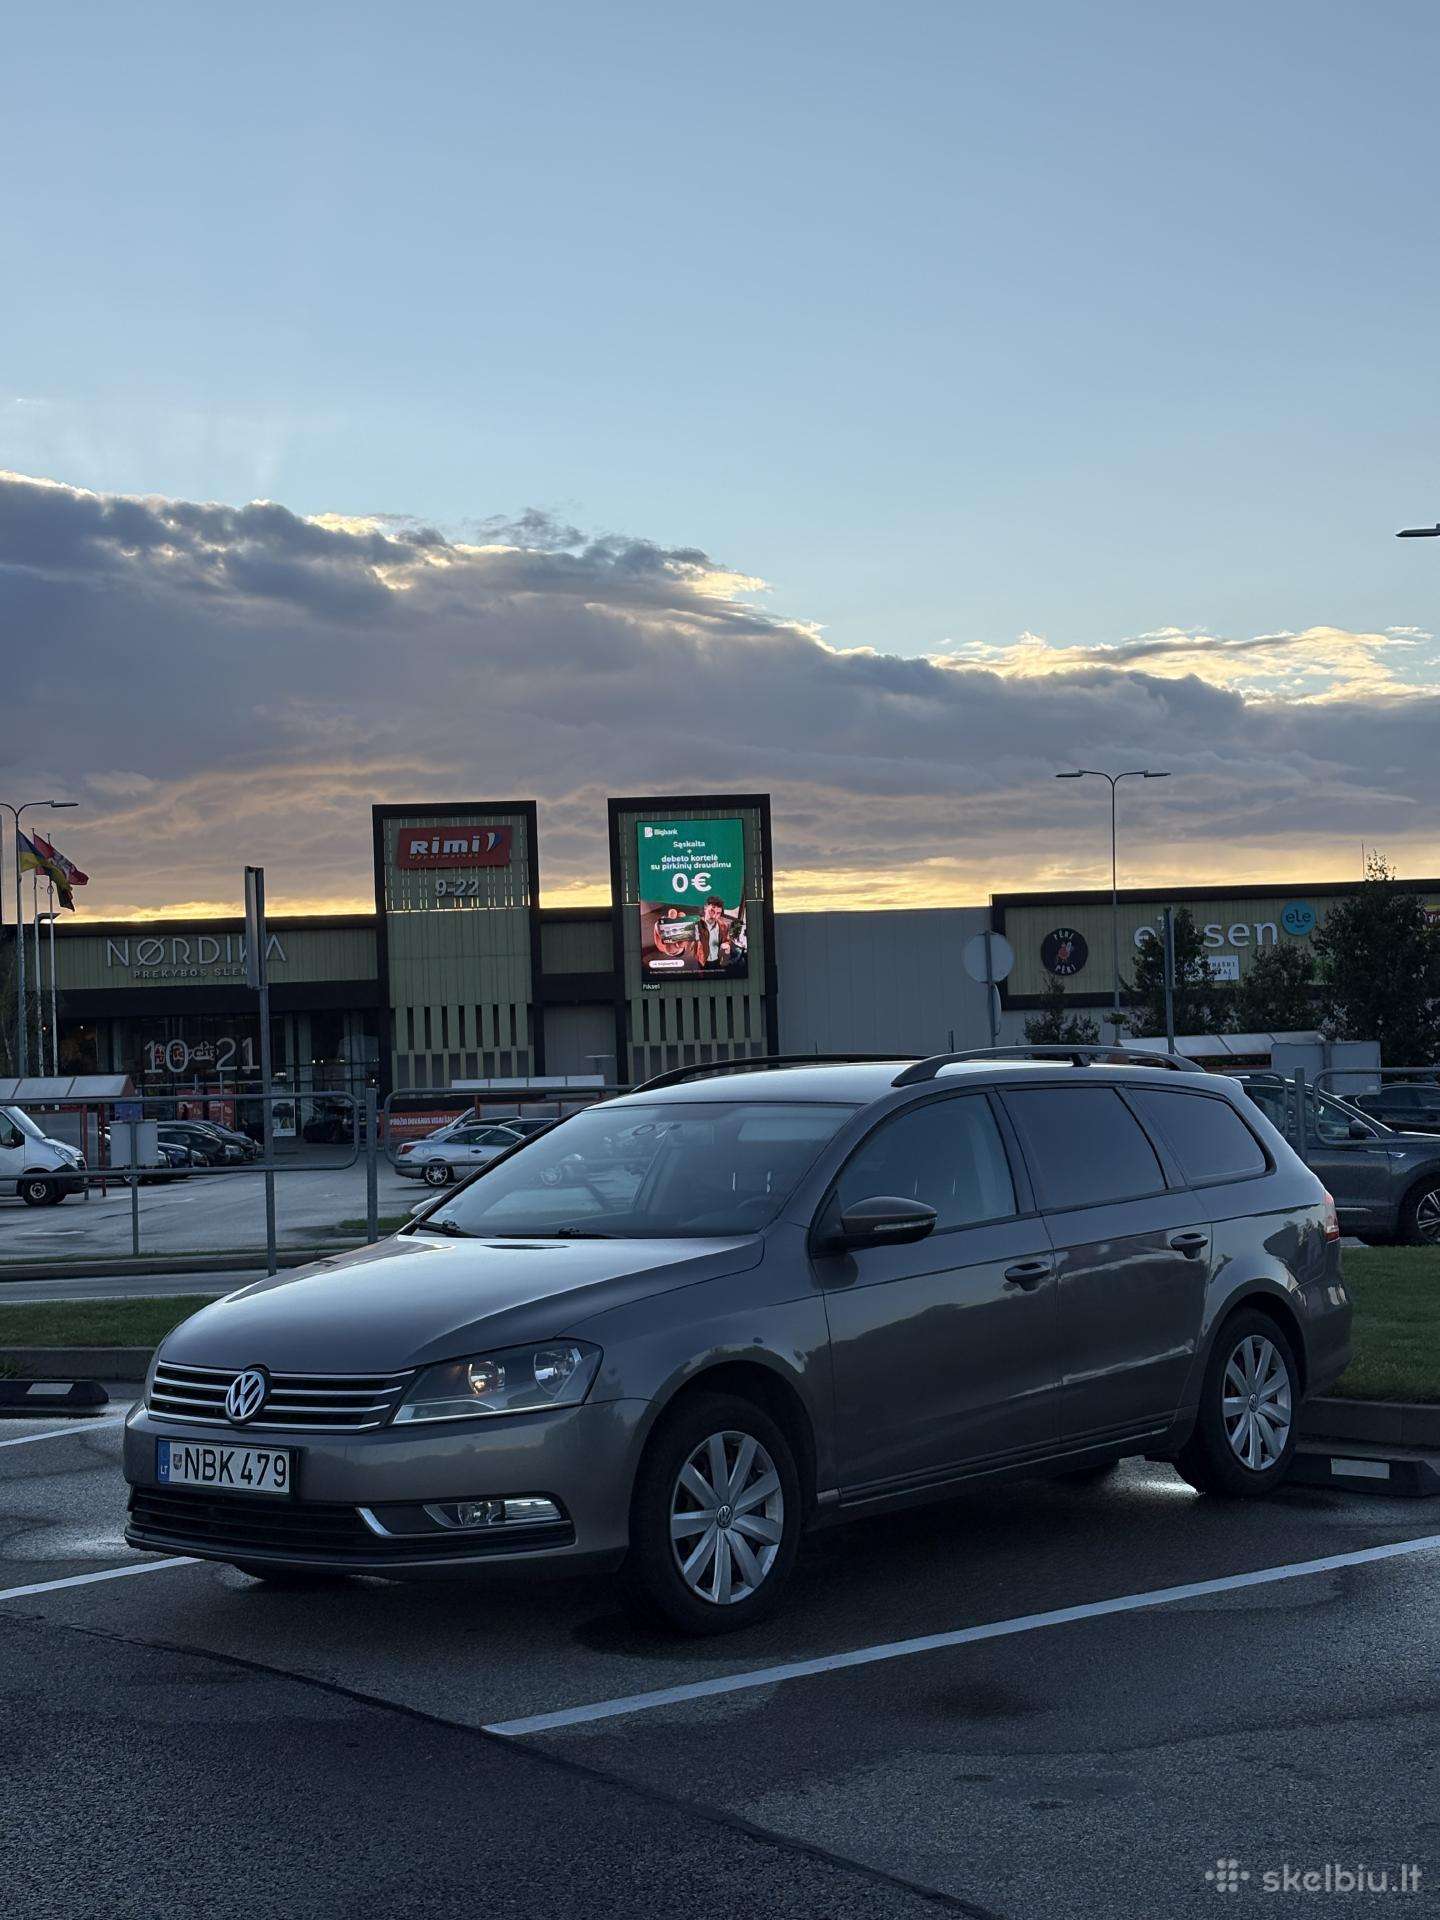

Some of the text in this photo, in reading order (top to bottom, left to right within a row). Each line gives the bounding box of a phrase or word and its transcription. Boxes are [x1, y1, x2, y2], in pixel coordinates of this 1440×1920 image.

[661, 853, 719, 863] debeto kortelė
[650, 861, 732, 871] su pirkinių draudimu
[434, 880, 479, 897] 9-22
[1133, 915, 1279, 948] esen
[133, 967, 208, 979] PREKYBOS
[160, 1446, 287, 1488] LT NBK 479
